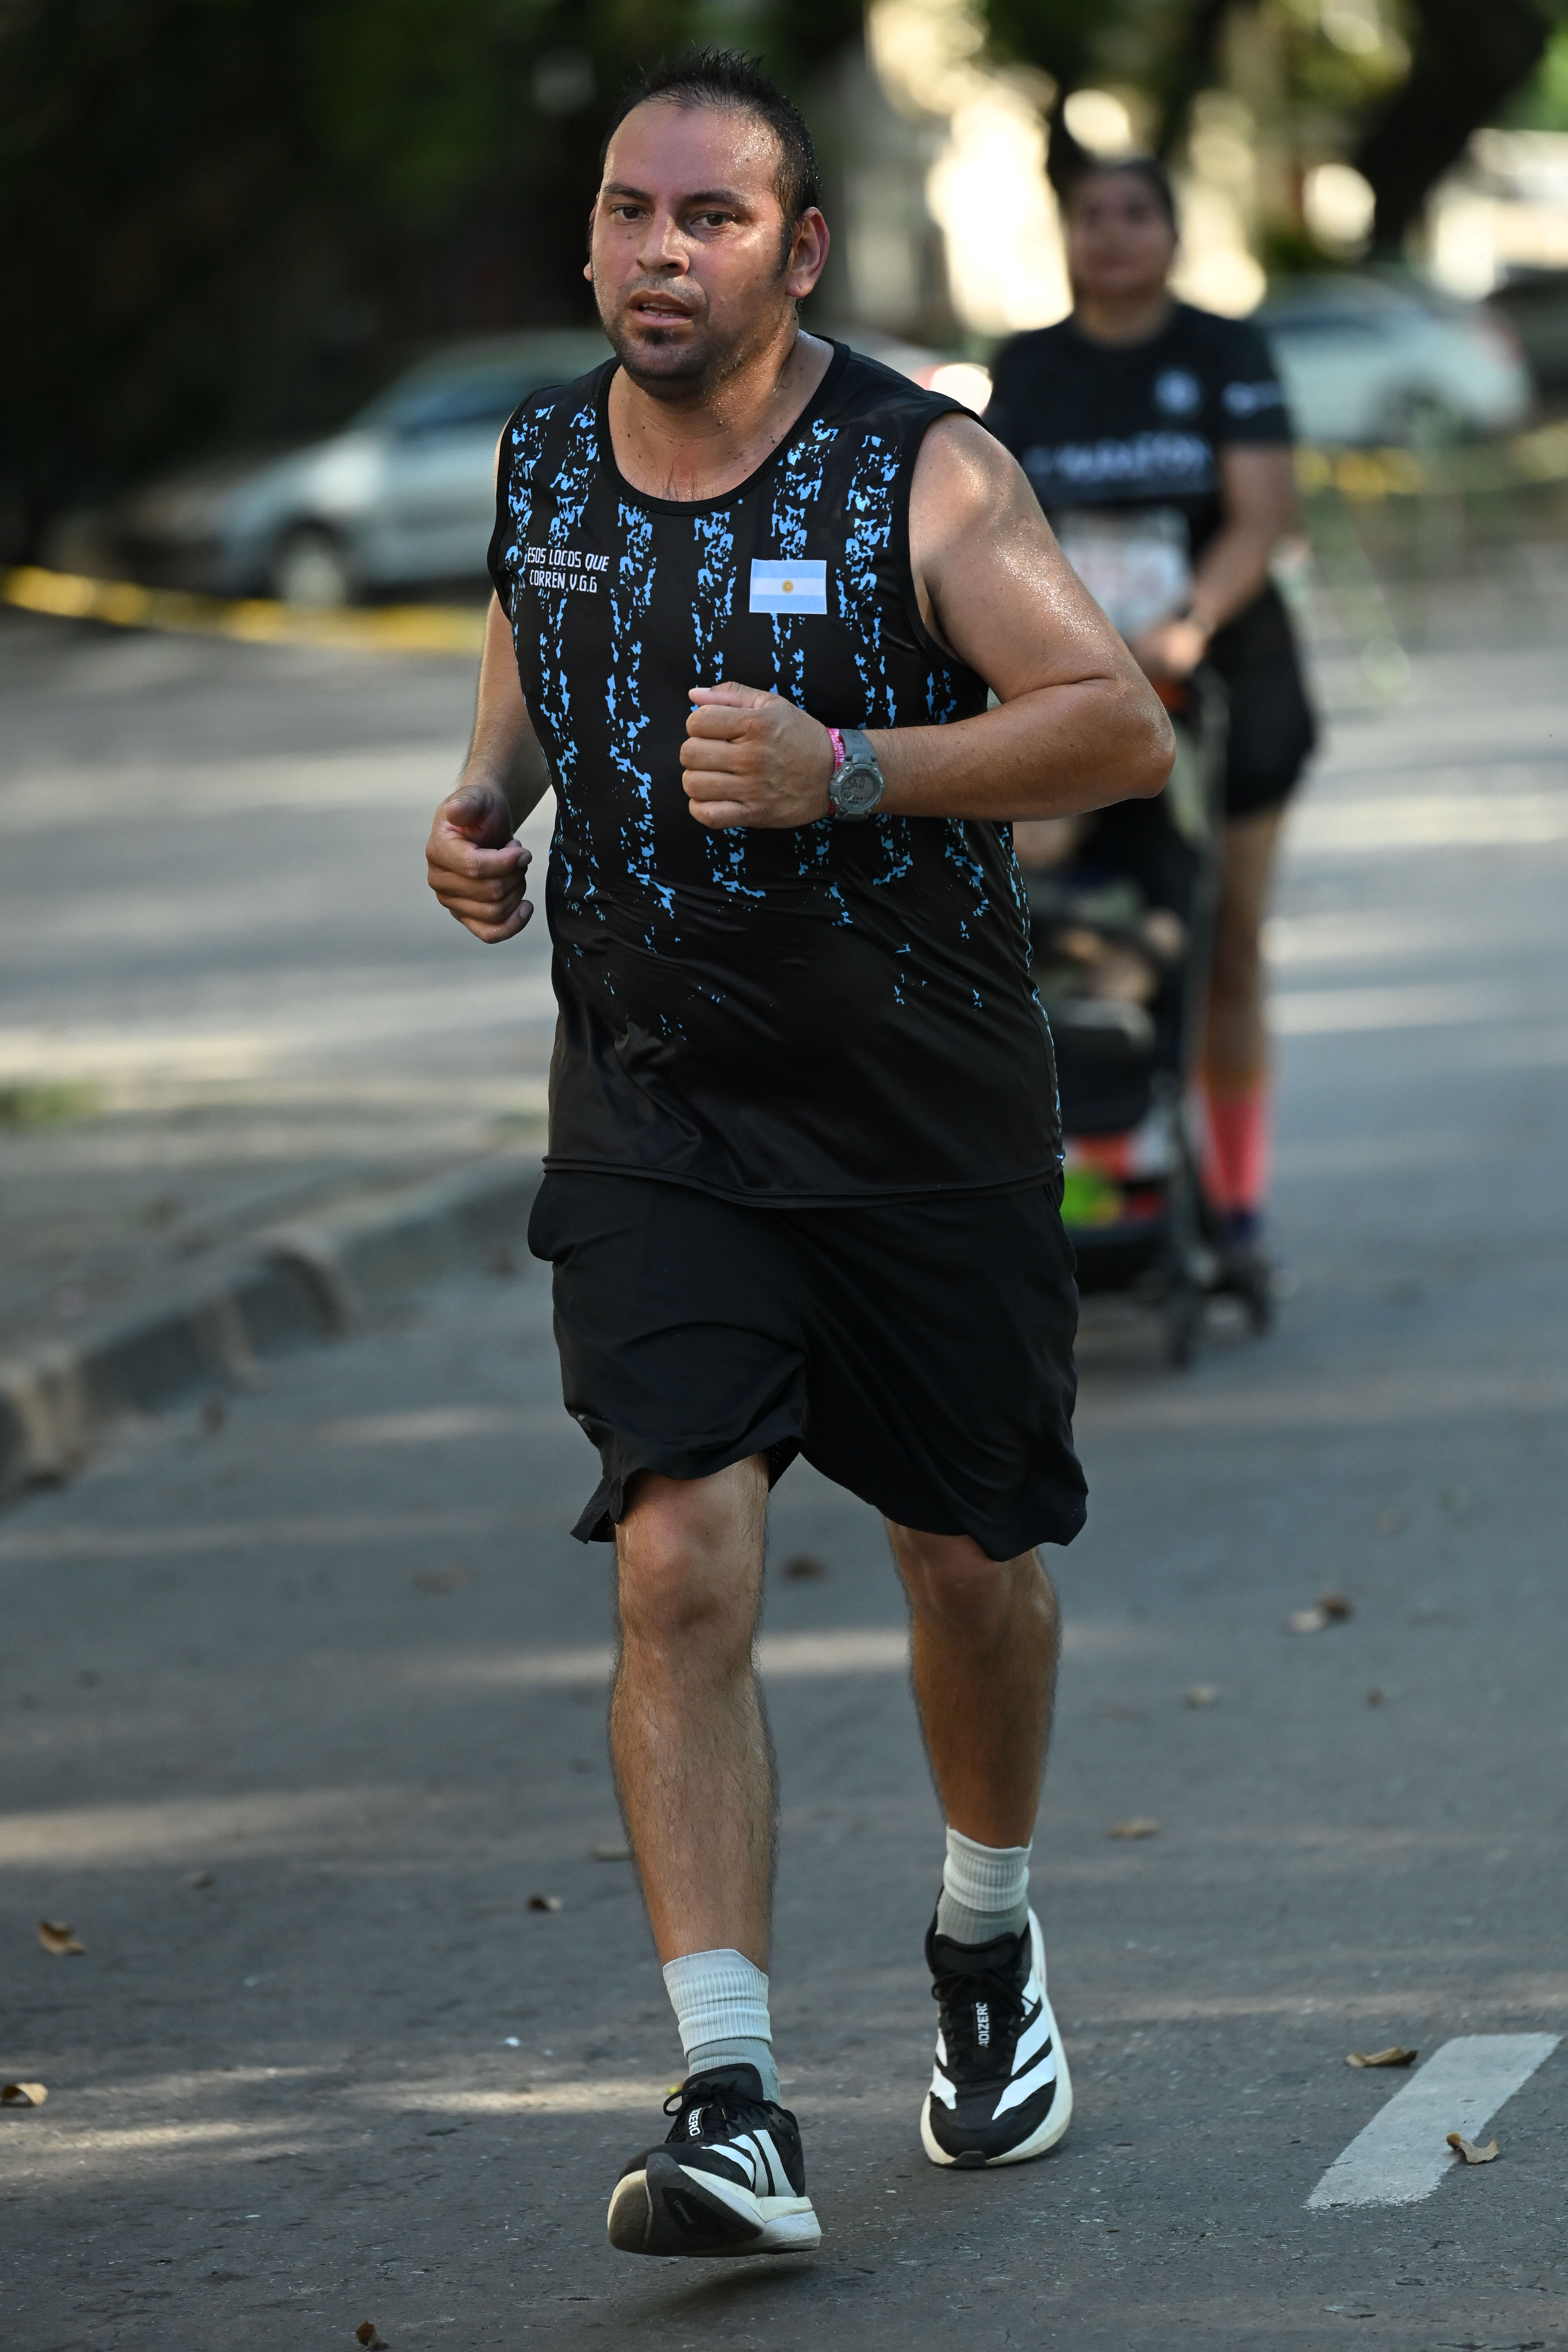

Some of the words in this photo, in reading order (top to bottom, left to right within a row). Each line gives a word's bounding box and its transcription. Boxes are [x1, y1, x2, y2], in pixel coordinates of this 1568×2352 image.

[527, 546, 547, 564] ESOS
[548, 549, 582, 568] LOCOS
[585, 553, 610, 572] QUE
[529, 569, 565, 589] CORREN
